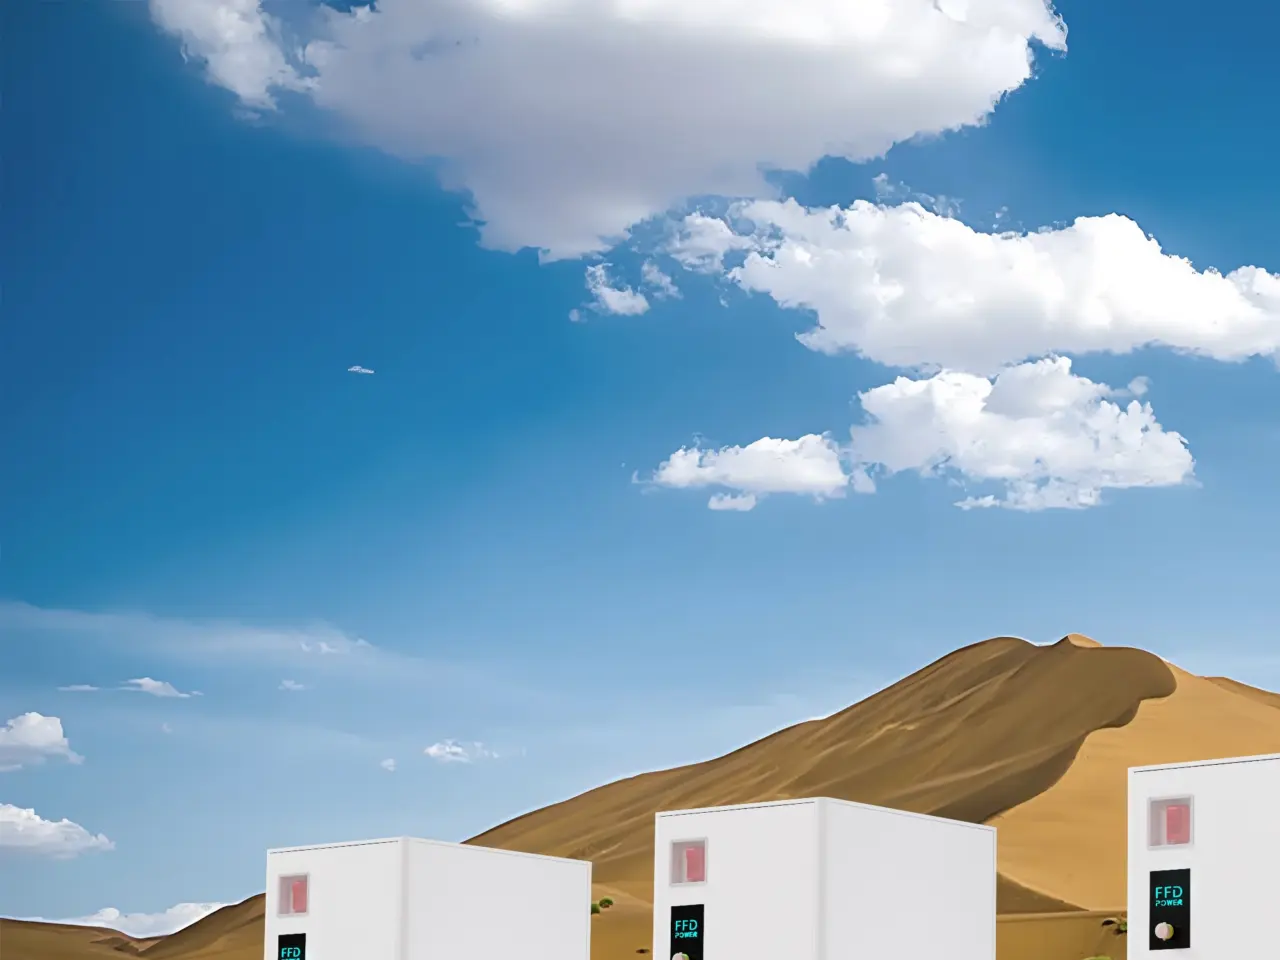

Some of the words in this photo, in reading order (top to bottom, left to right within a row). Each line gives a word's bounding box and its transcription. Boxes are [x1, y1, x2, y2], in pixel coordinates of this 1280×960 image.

[1155, 885, 1183, 898] FFD
[1155, 898, 1183, 906] POWER
[675, 919, 697, 931] FFD
[674, 930, 697, 938] POWER
[281, 947, 301, 958] FFD
